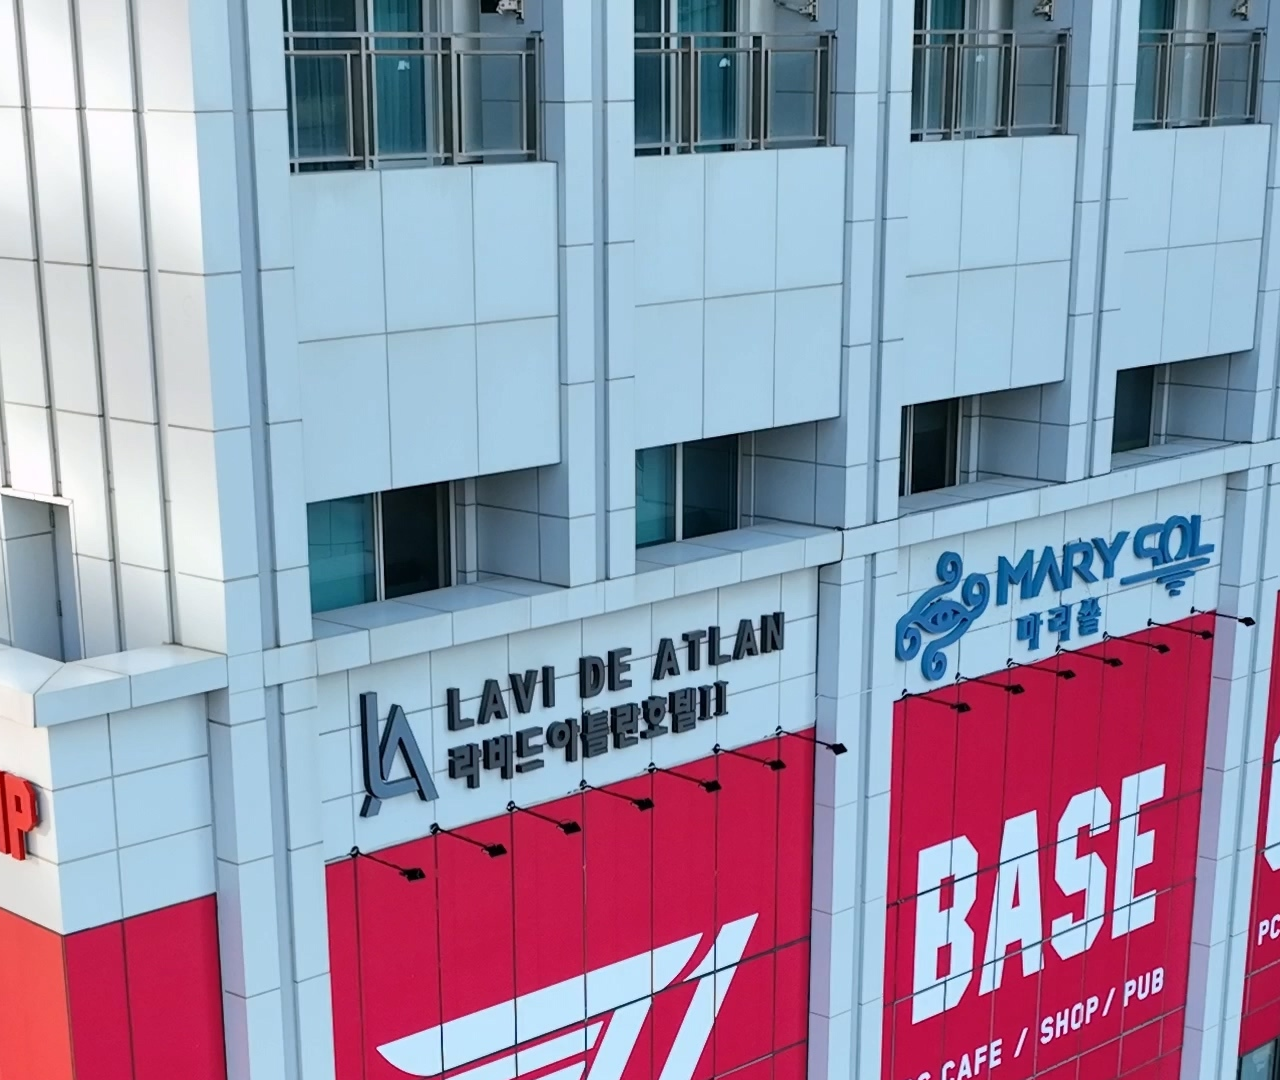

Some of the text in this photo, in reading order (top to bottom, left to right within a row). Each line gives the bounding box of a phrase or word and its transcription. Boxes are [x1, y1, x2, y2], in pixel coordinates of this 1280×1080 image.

[447, 611, 785, 731] LAVI DE ATLAN
[911, 763, 1167, 1026] BASE
[1013, 1027, 1029, 1058] /
[1040, 995, 1100, 1045] SHOP
[1102, 987, 1117, 1017] /
[1123, 966, 1165, 1007] PUB
